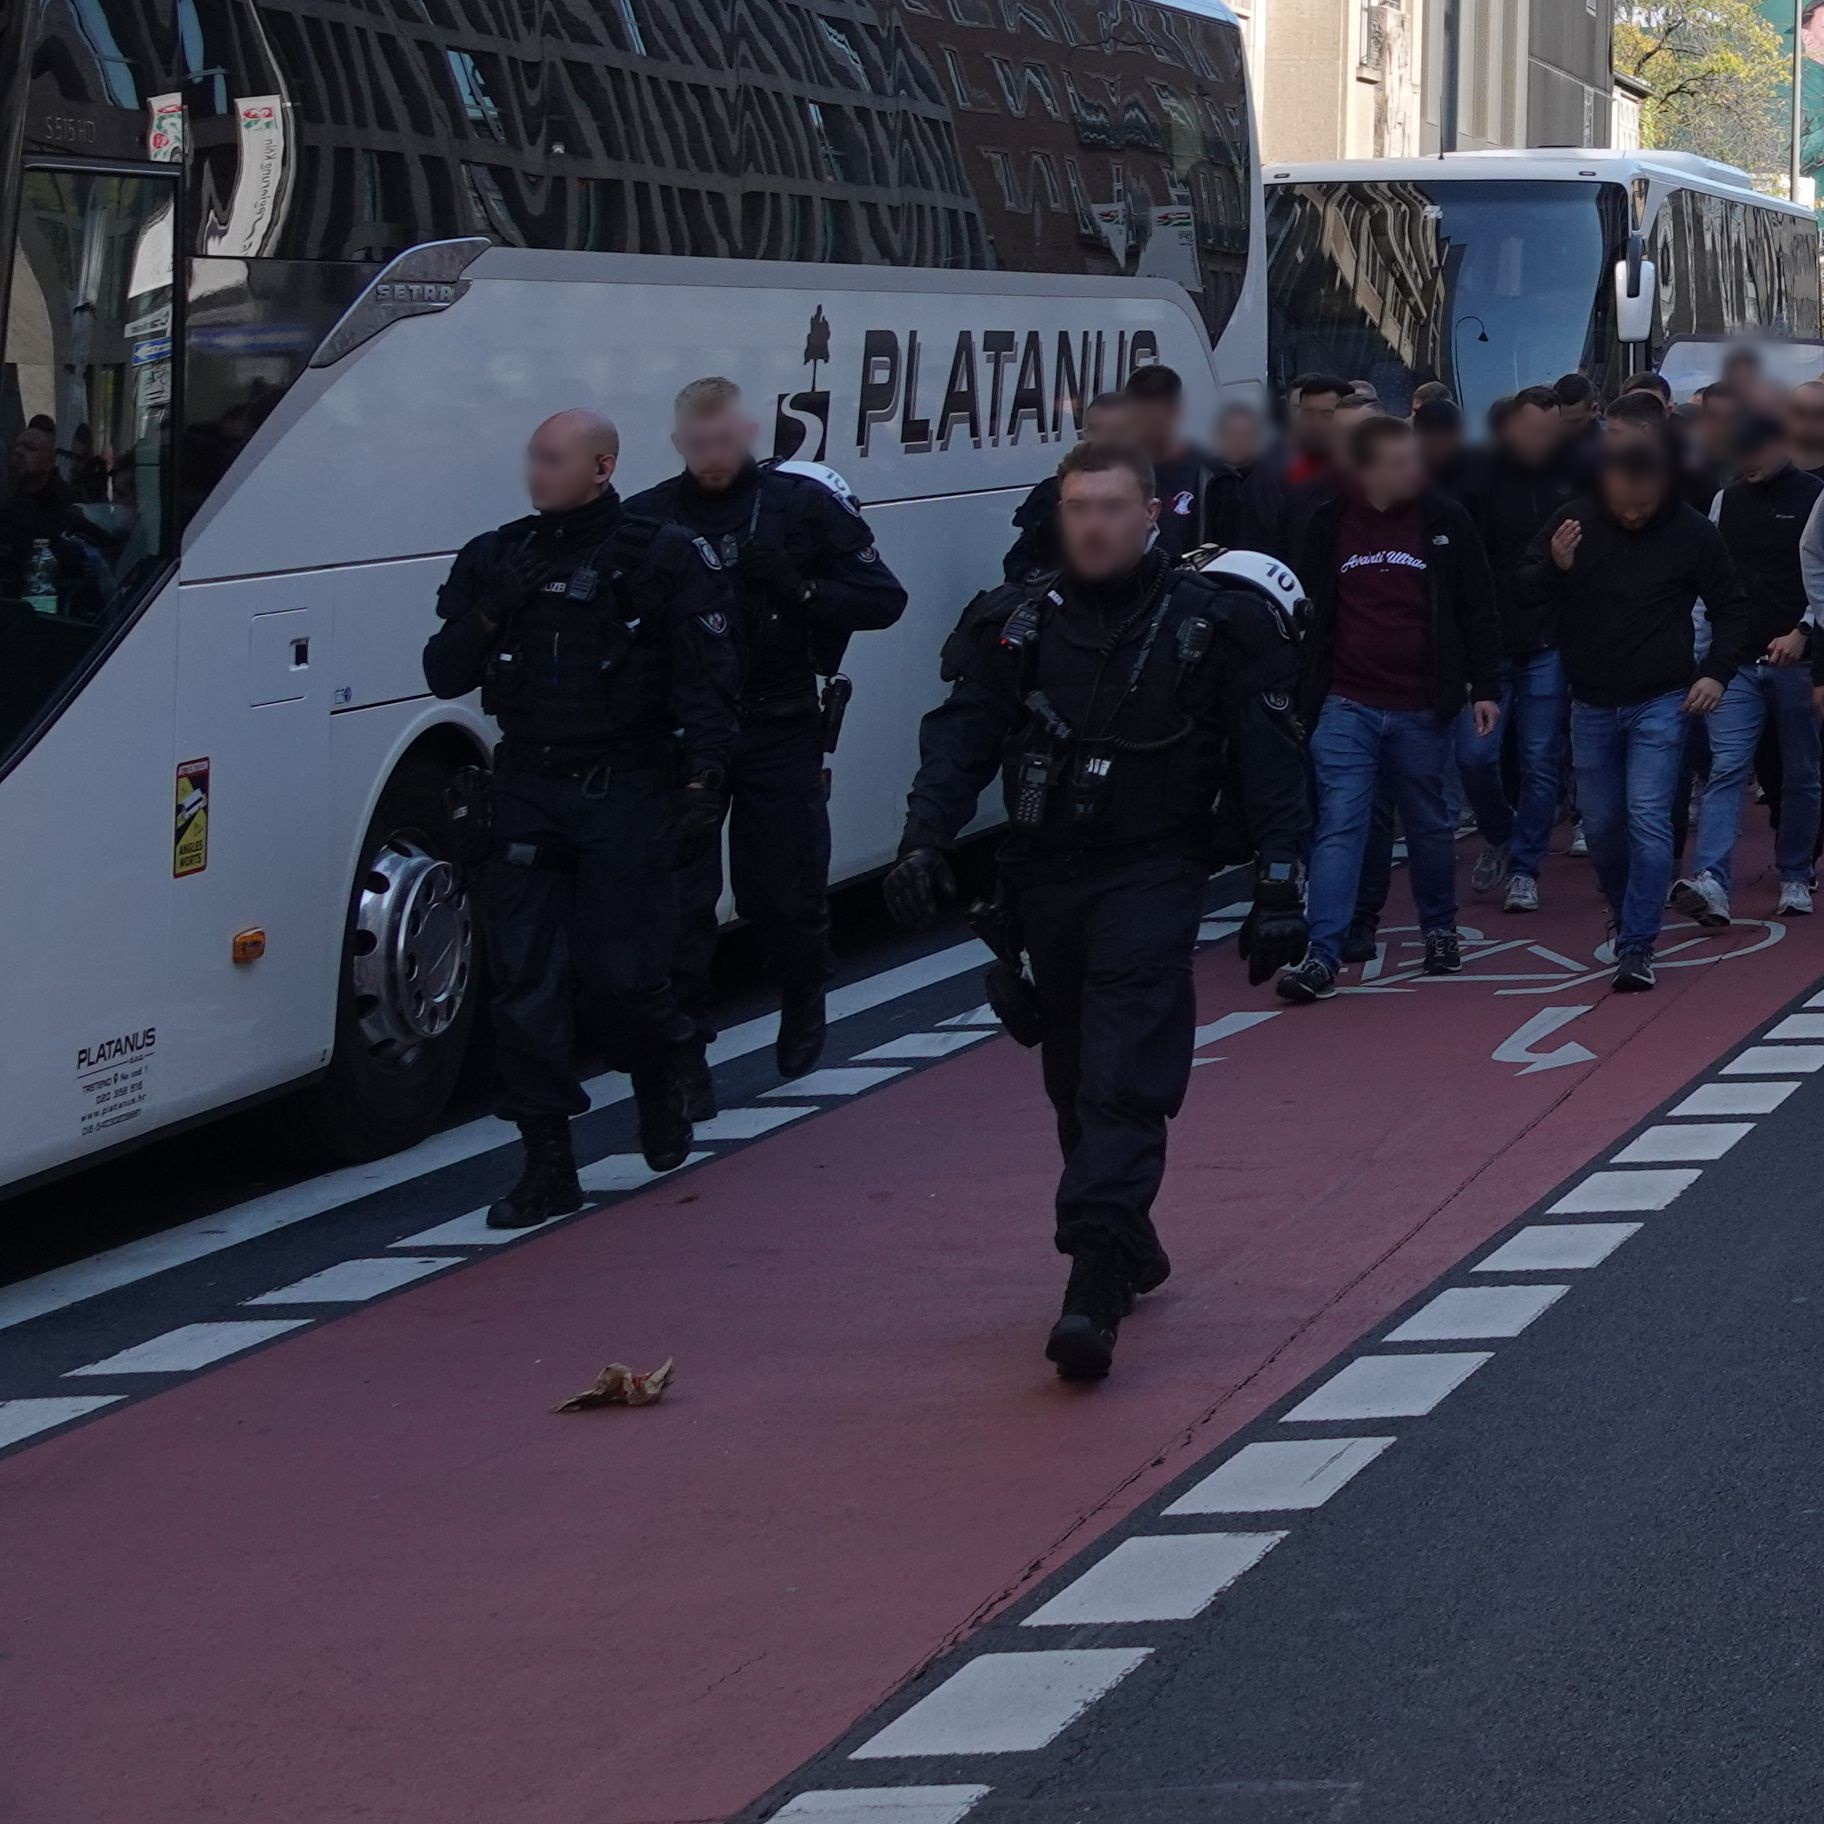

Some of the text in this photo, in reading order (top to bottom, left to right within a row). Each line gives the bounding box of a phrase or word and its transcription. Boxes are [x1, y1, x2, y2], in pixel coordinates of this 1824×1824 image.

[376, 284, 455, 303] SETRA
[856, 330, 1159, 458] PLATANU
[1265, 562, 1296, 592] 10
[1340, 550, 1428, 574] Avanti Ultras
[77, 1027, 156, 1071] PLATANUS
